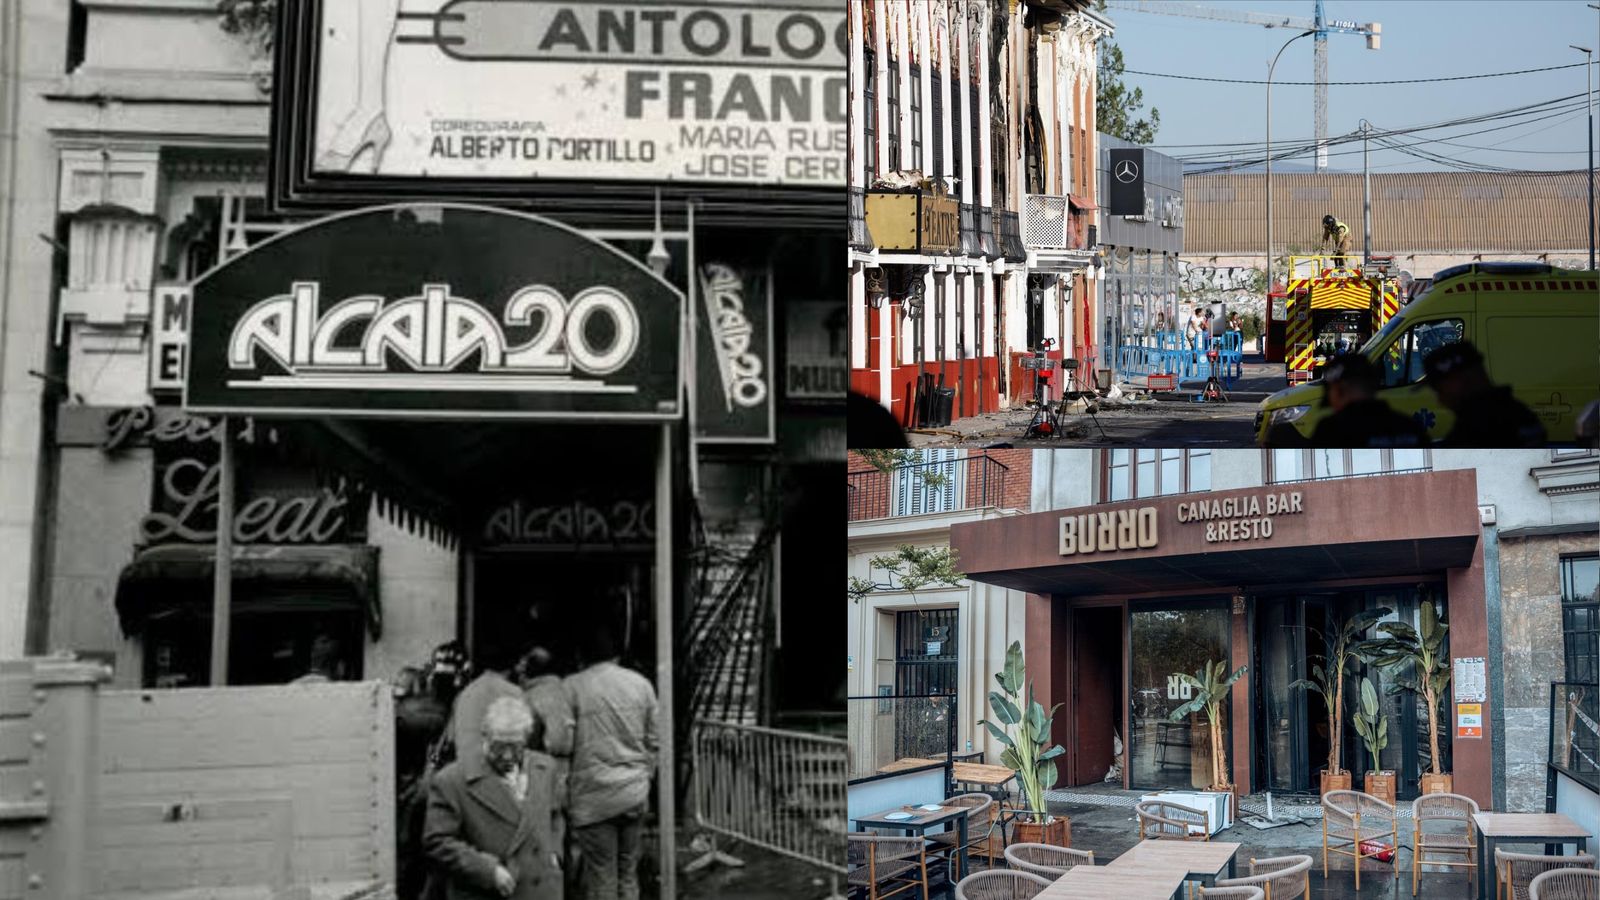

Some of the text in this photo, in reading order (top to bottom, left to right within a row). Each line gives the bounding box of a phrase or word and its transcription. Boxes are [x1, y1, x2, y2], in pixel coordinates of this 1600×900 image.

[430, 135, 656, 162] ALBERTO PORTILLO
[679, 125, 776, 150] MARIA
[685, 155, 769, 178] JOSE
[1177, 491, 1303, 523] CANAGLIA BAR
[1059, 506, 1158, 556] BURRO
[1206, 517, 1274, 543] &RESTO
